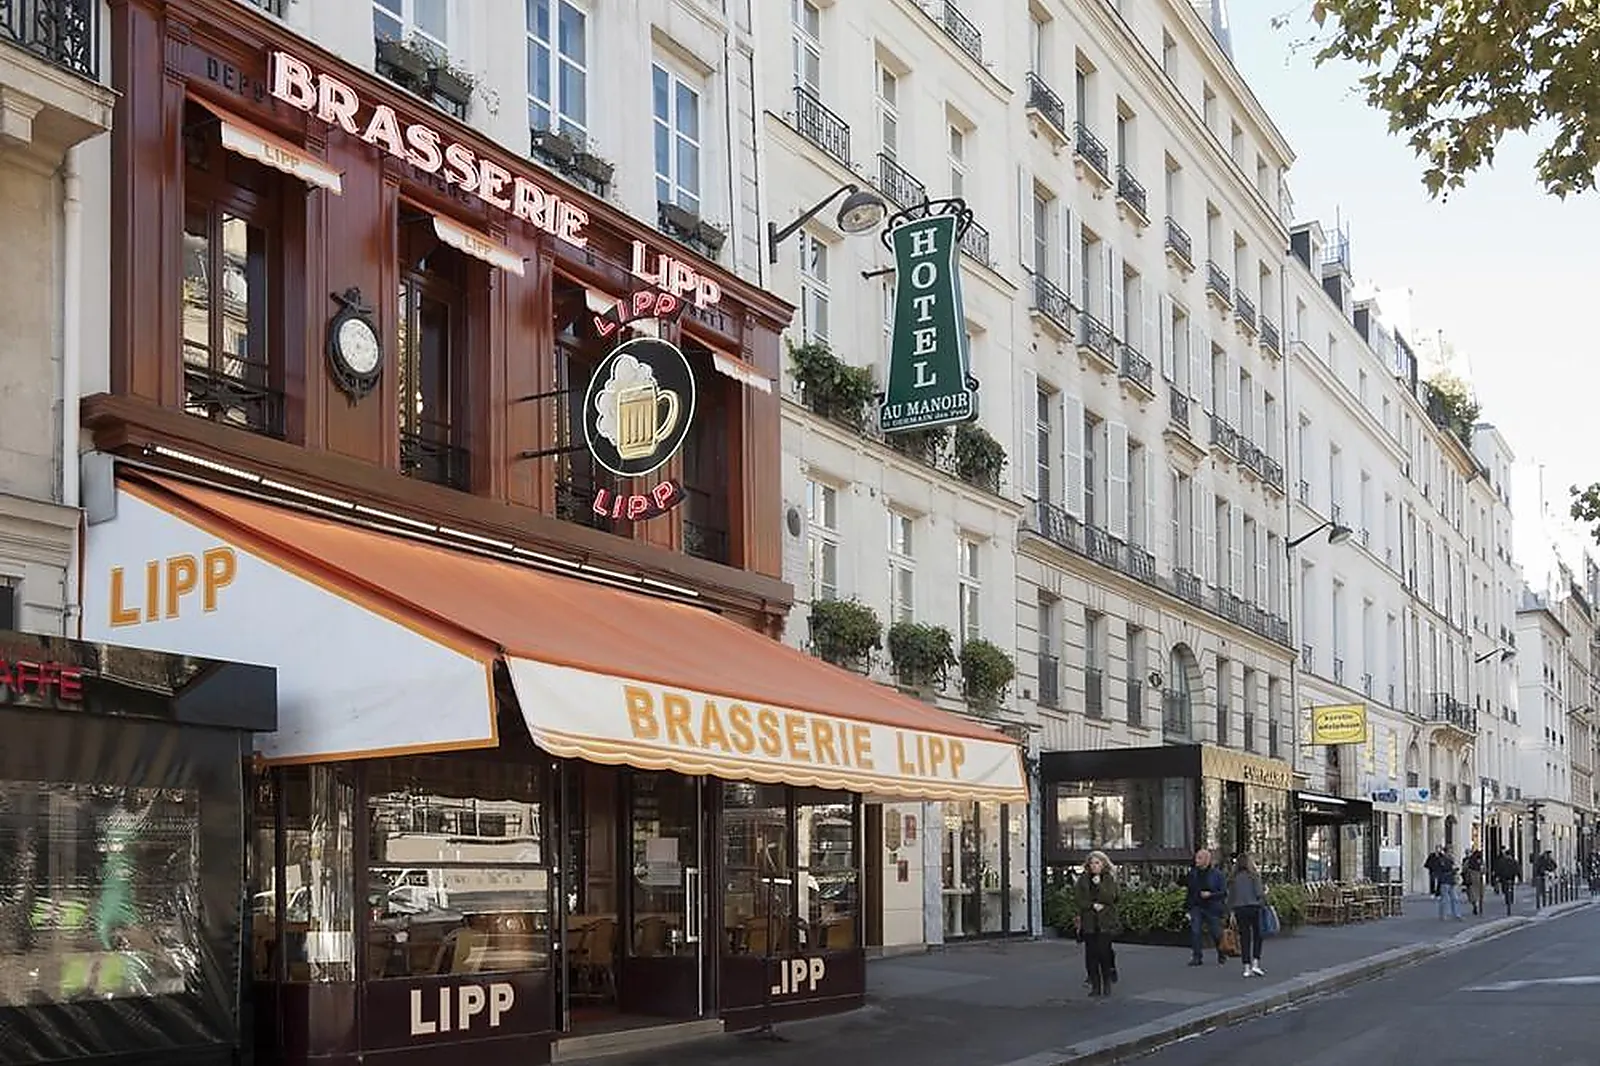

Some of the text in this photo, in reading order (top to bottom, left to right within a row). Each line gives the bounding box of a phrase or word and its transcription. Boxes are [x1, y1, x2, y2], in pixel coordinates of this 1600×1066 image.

[264, 144, 299, 169] LIPP
[268, 50, 722, 310] BRASSERIE LIPP
[593, 290, 677, 337] LIPP
[909, 226, 939, 389] HOTEL
[882, 391, 968, 420] AU MANOIR
[592, 481, 674, 520] LIPP
[109, 546, 237, 627] LIPP
[623, 684, 966, 778] BRASSERIE LIPP
[771, 957, 825, 994] IPP
[410, 982, 515, 1035] LIPP
